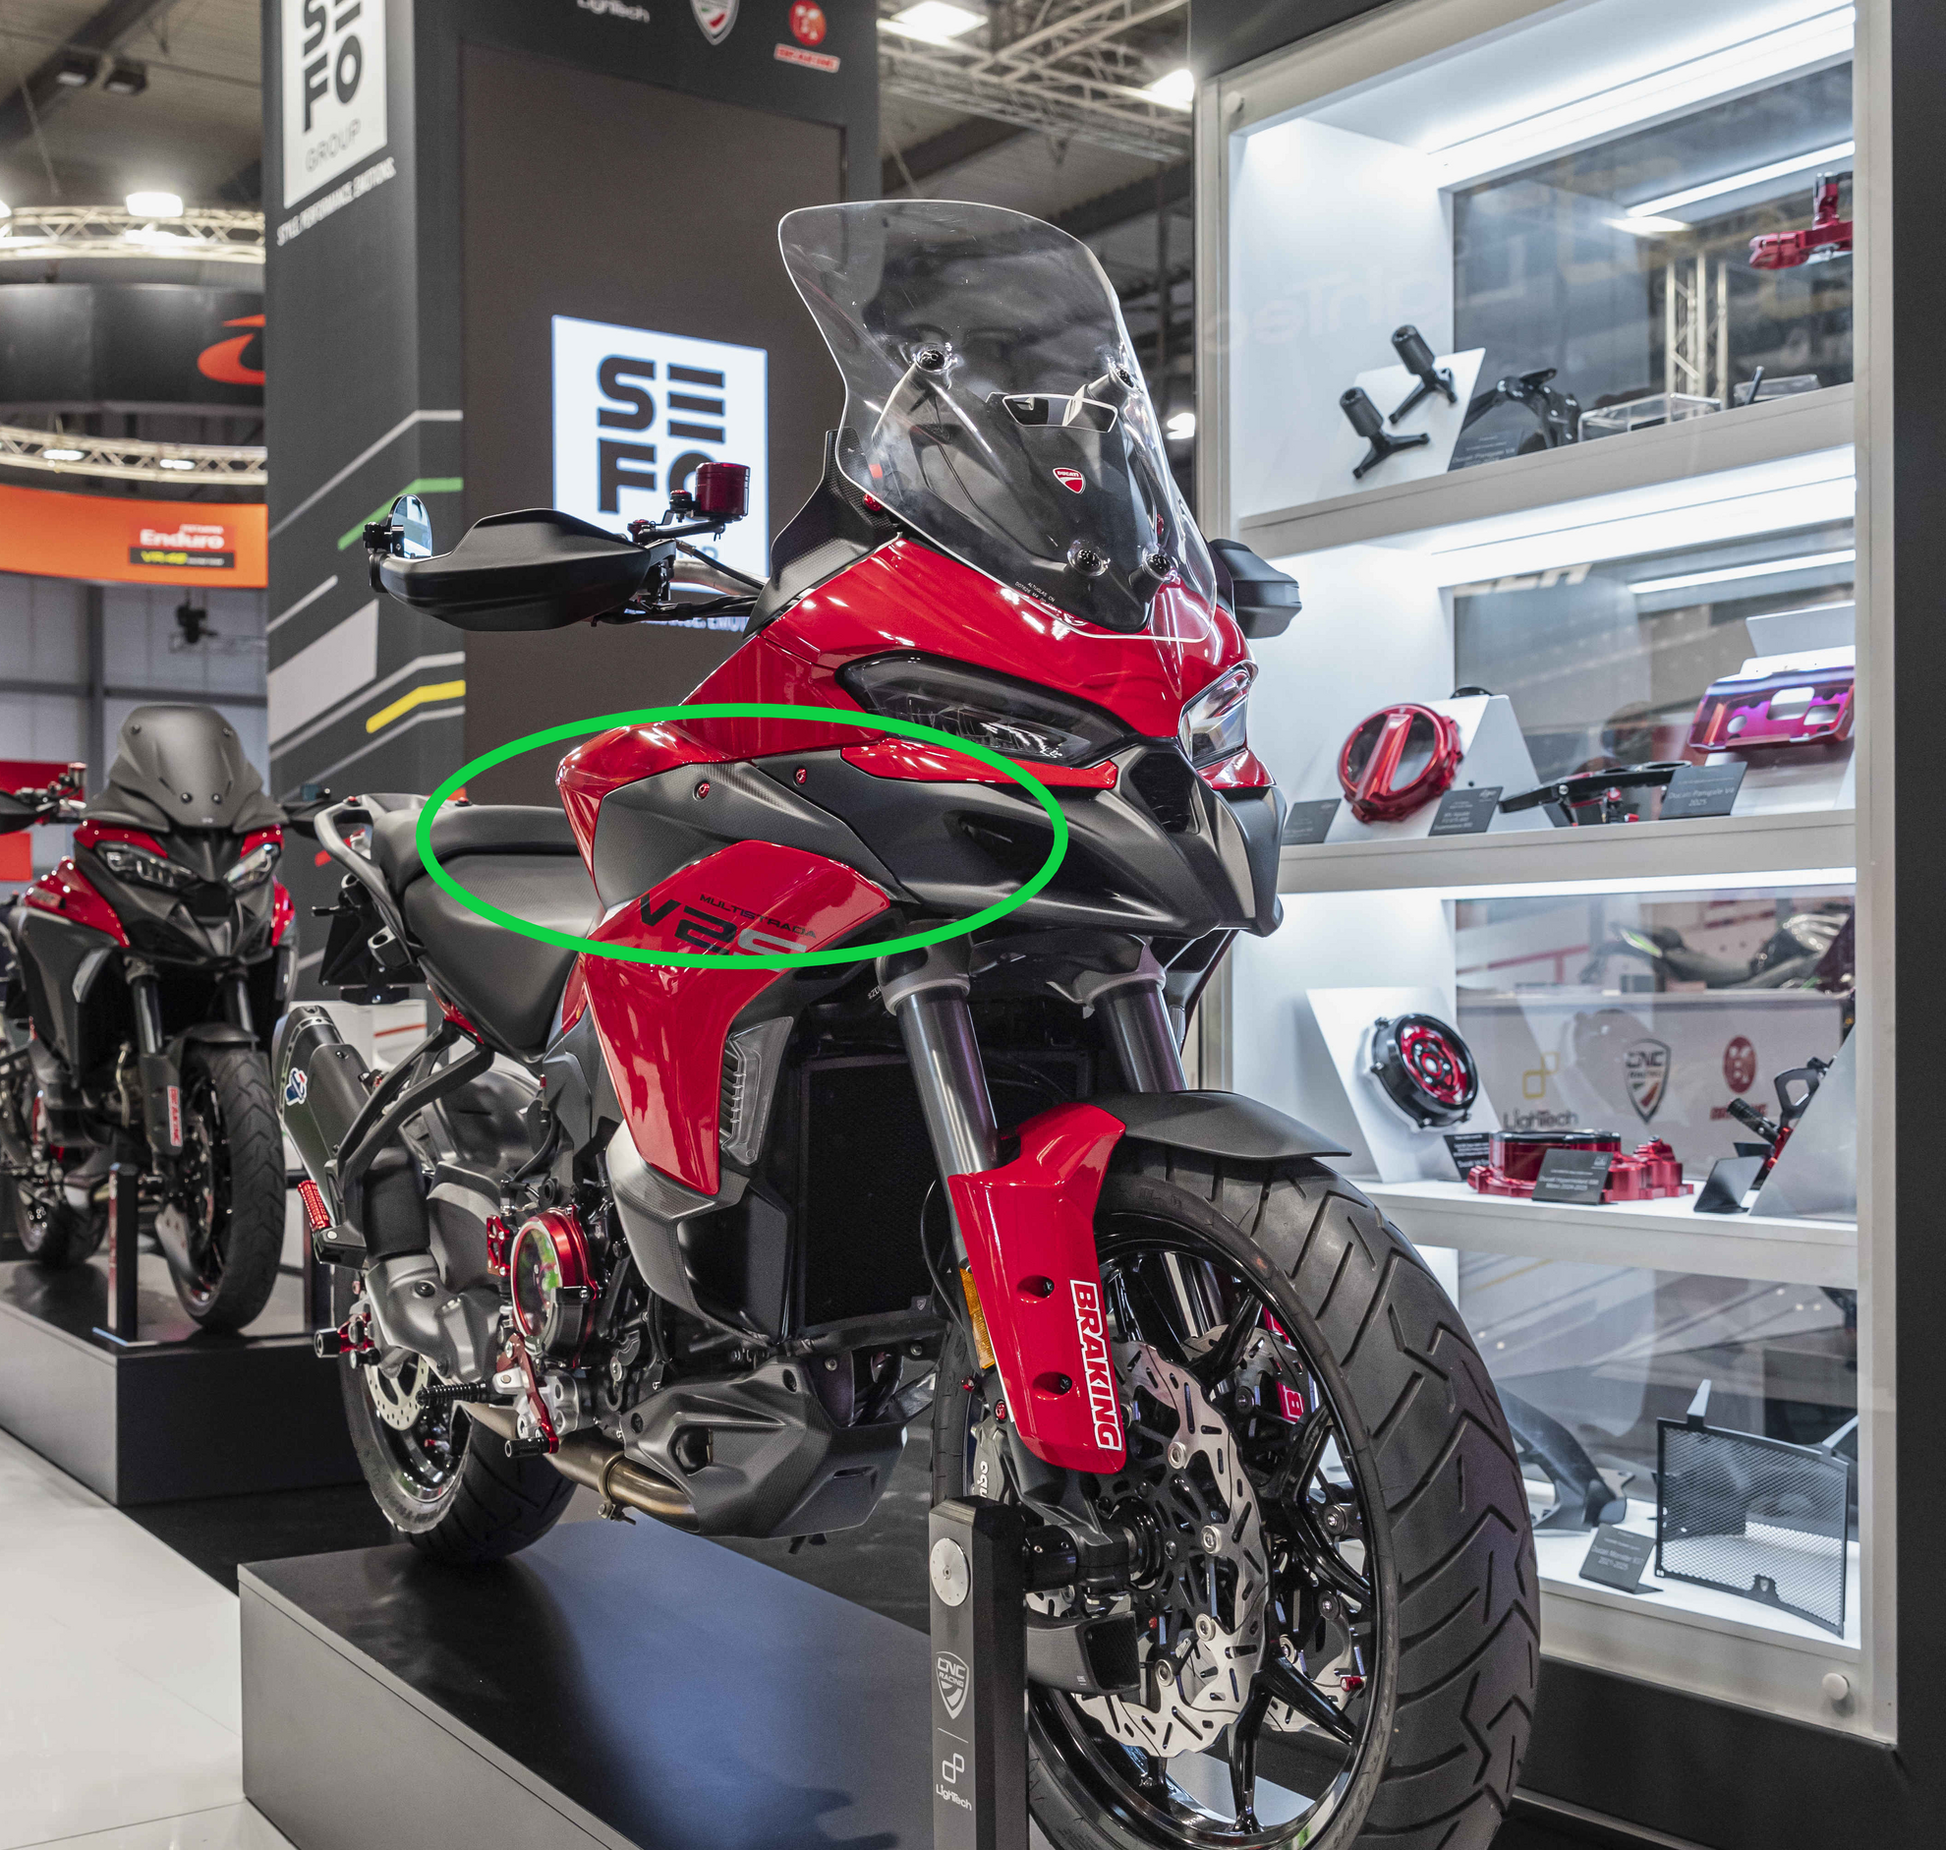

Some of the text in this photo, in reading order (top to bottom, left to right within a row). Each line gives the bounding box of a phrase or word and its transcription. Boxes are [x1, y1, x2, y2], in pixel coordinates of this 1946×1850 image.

[303, 34, 362, 133] FO
[306, 118, 361, 171] GROUP
[597, 354, 725, 444] SE
[140, 529, 225, 549] Enduro
[700, 893, 817, 939] MULTISTRADA
[1070, 1279, 1124, 1452] BRAKING
[937, 1656, 966, 1680] CNC
[938, 1671, 965, 1689] RACING
